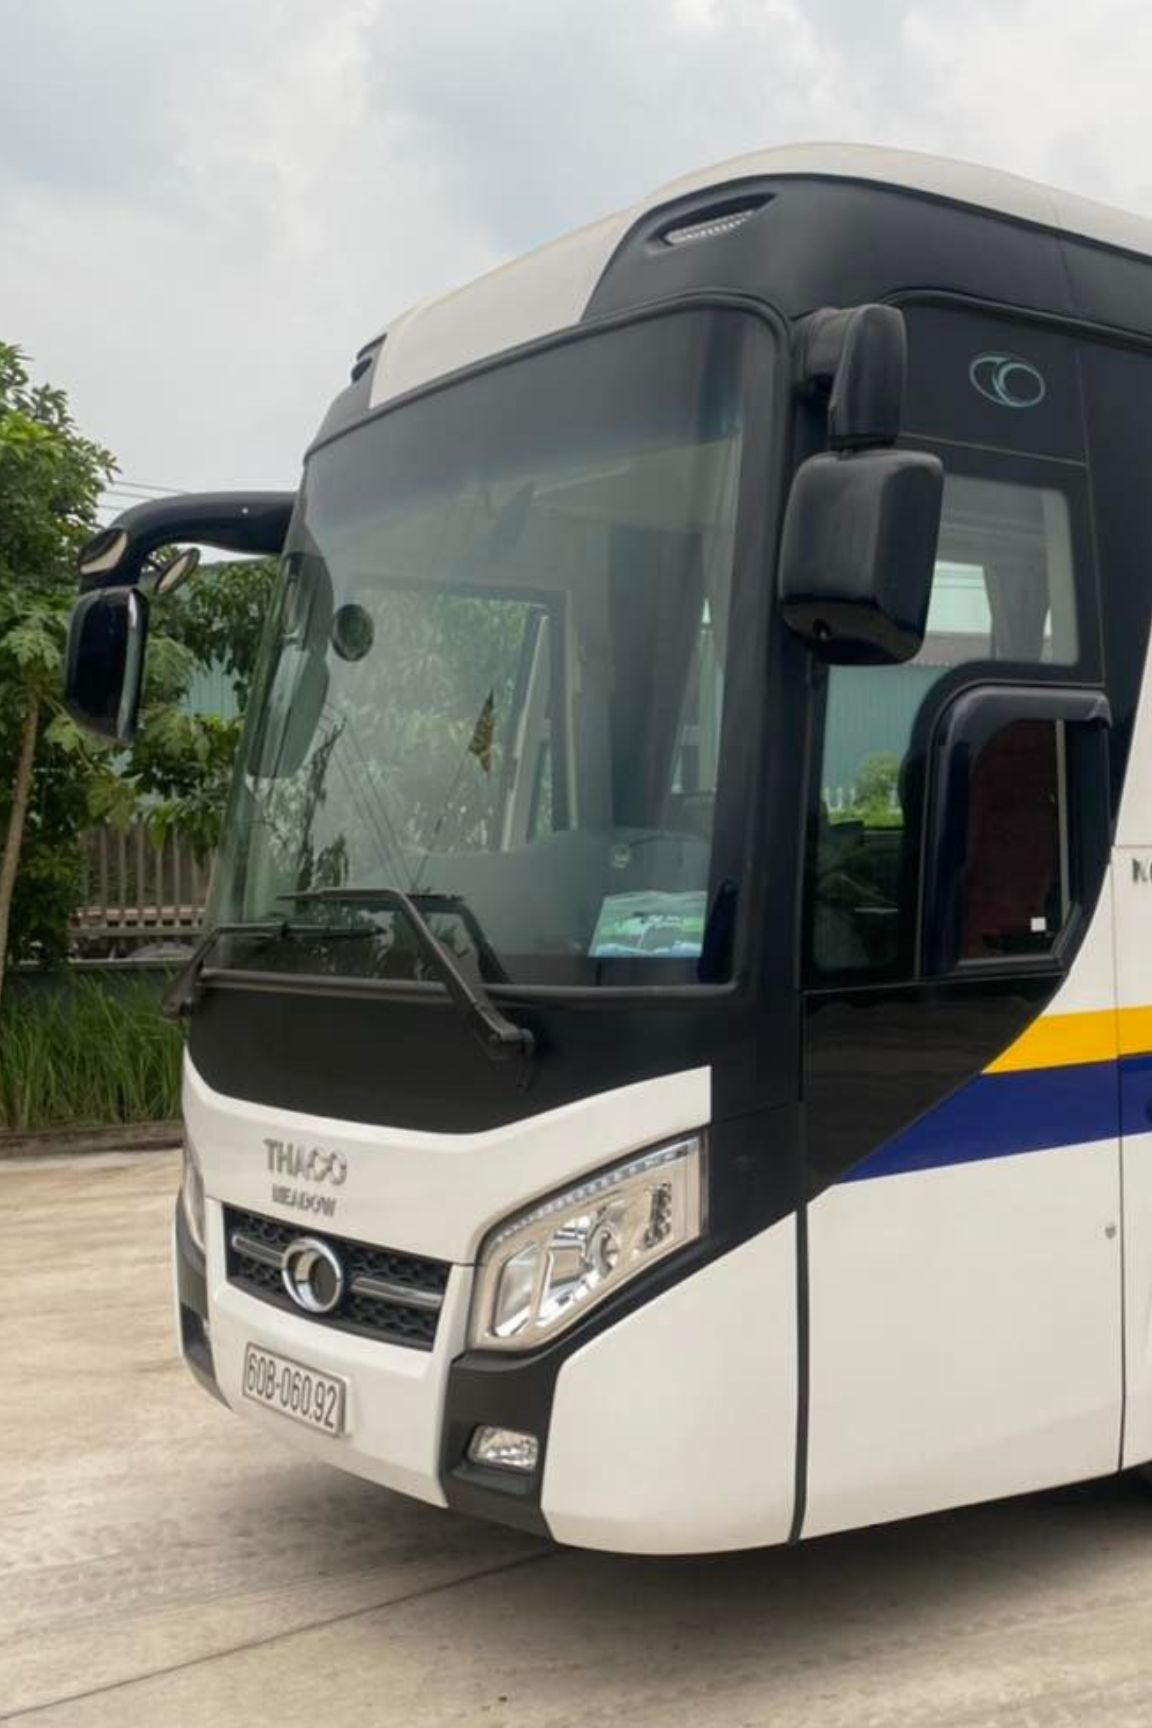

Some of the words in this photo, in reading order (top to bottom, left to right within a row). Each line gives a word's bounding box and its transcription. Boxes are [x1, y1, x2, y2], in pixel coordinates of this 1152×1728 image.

[263, 1138, 348, 1186] THACO
[272, 1184, 337, 1217] MEADOW
[247, 1353, 338, 1429] 60B-060.92
